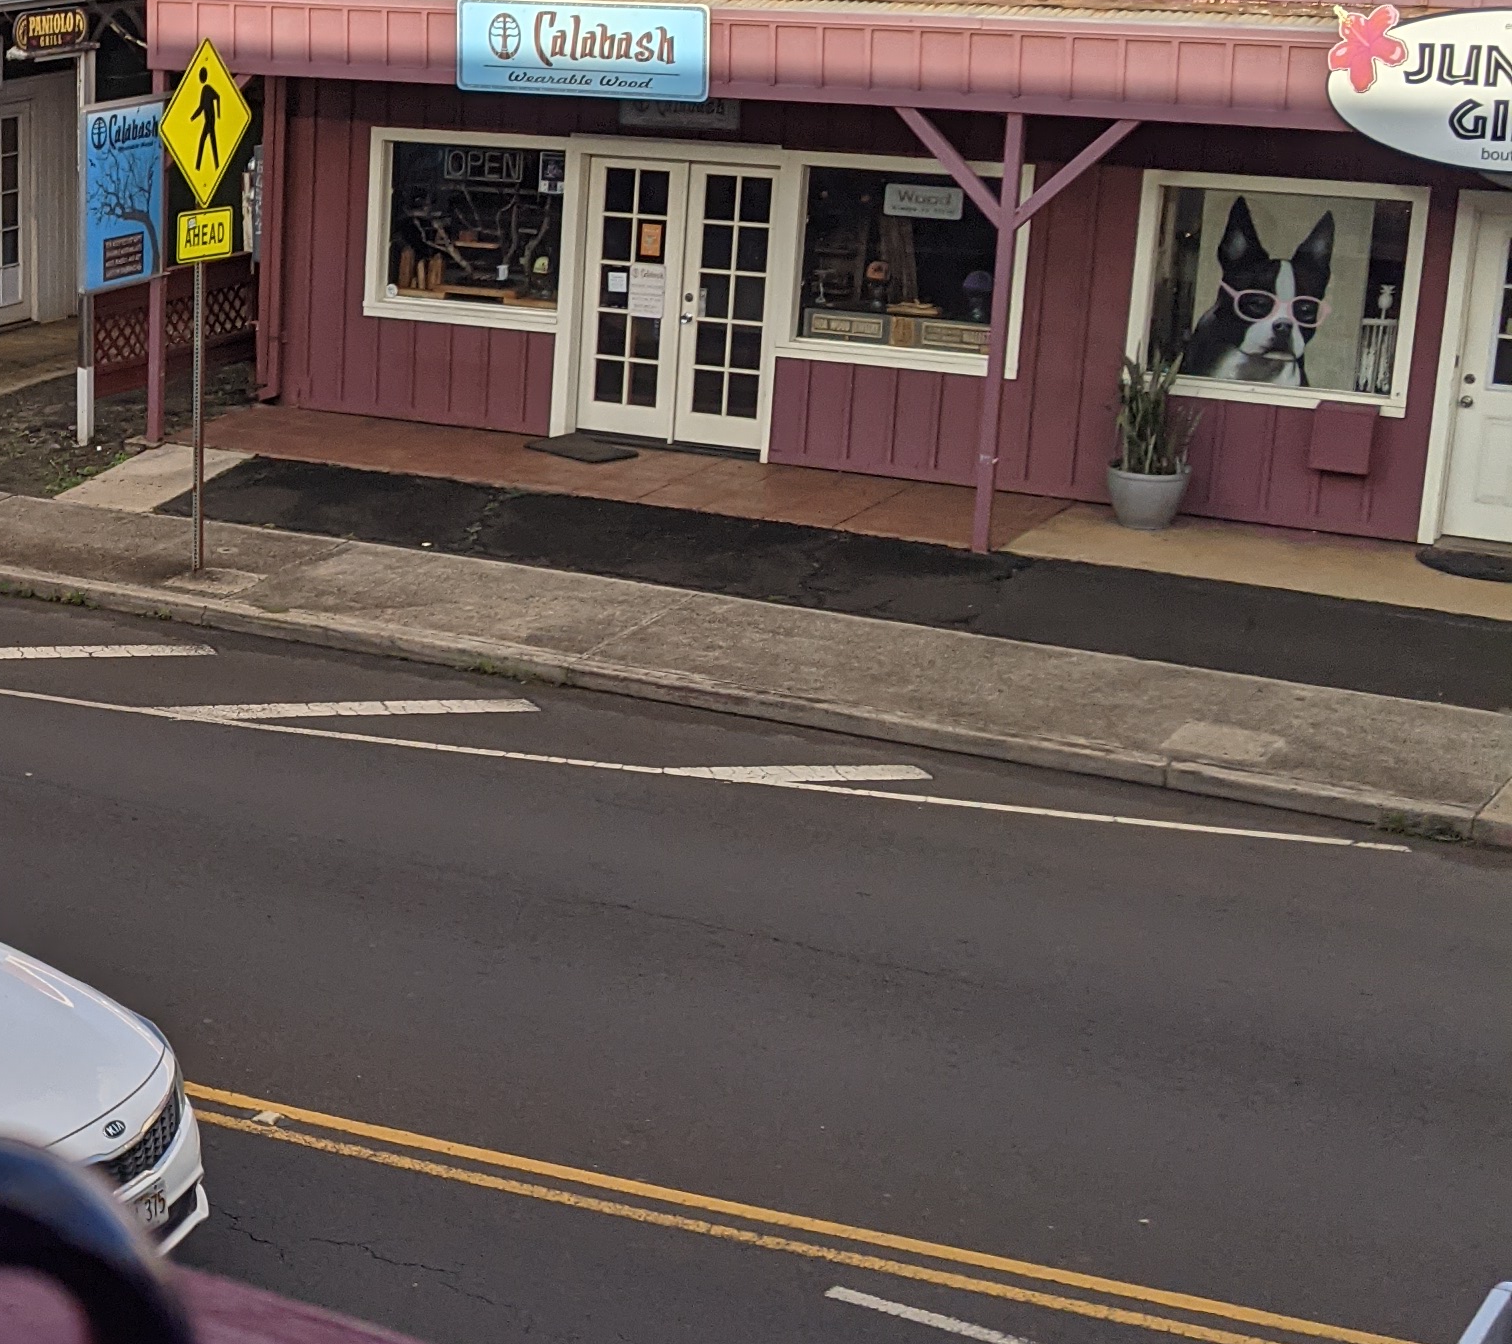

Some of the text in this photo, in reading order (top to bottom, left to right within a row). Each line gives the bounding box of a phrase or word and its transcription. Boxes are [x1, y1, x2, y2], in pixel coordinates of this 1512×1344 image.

[28, 11, 74, 37] PANIOLO
[39, 34, 62, 47] GRILL
[534, 10, 676, 67] Calabash
[508, 70, 653, 89] Wearable Wood
[109, 114, 159, 150] Calabash
[1448, 98, 1512, 142] GI
[449, 150, 520, 180] OPEN
[1481, 147, 1512, 161] bou
[184, 221, 225, 248] AHEAD
[106, 1121, 125, 1136] KIA
